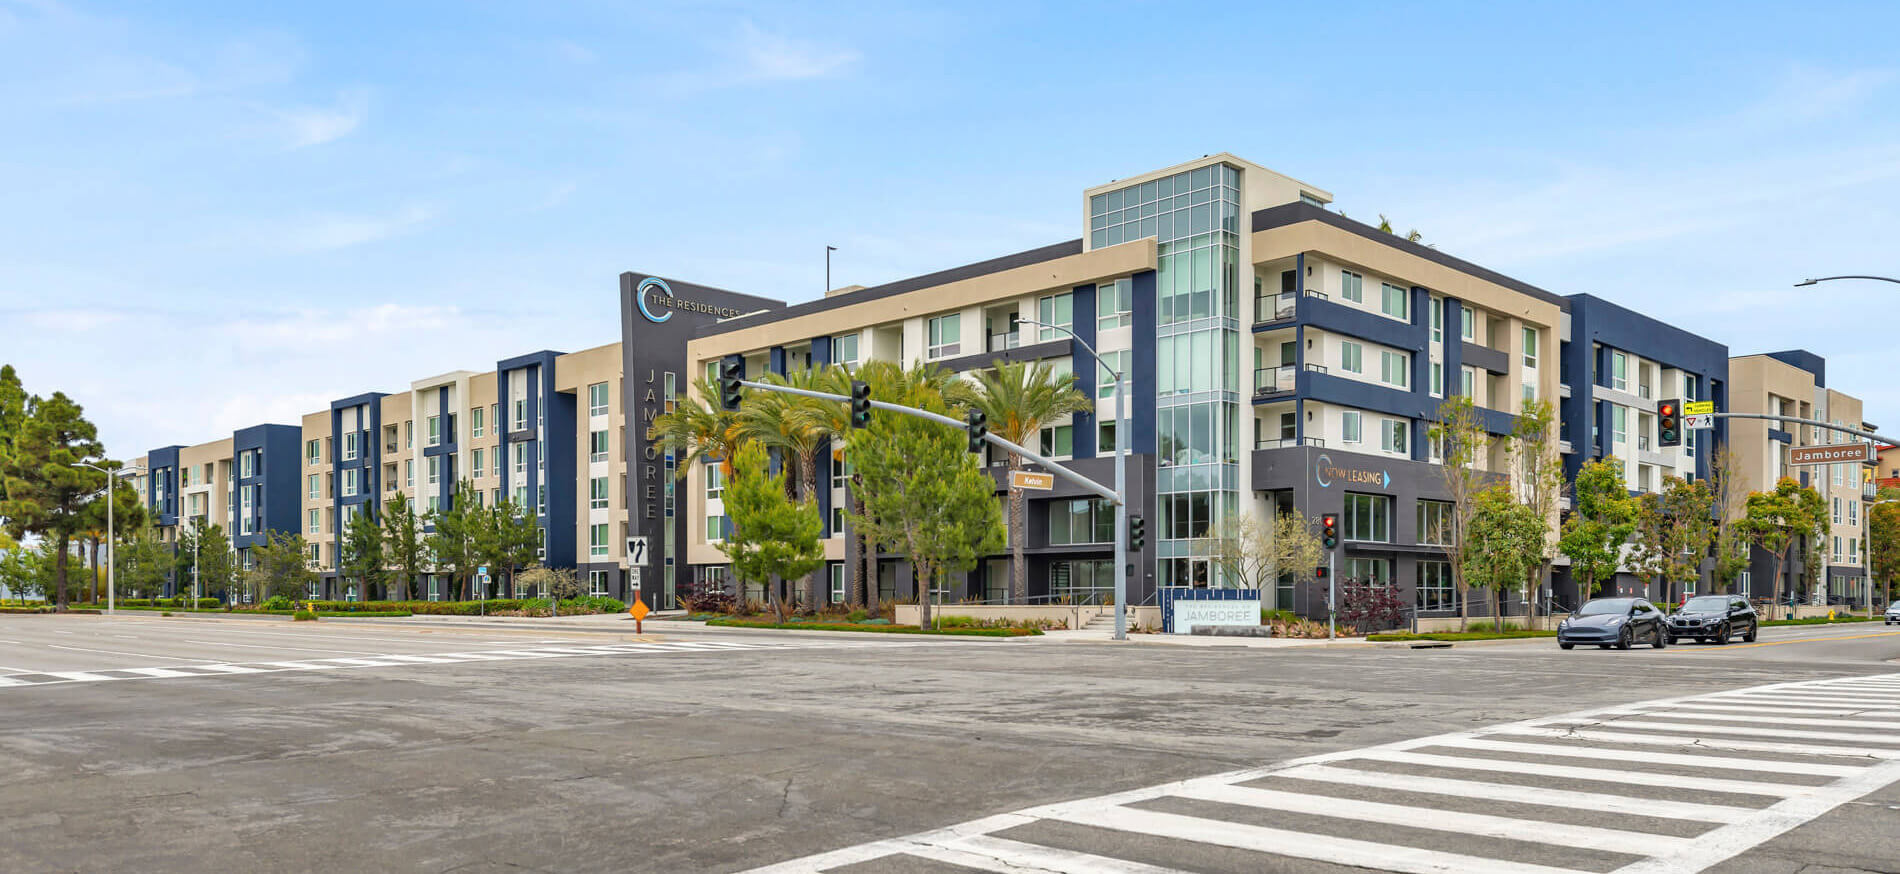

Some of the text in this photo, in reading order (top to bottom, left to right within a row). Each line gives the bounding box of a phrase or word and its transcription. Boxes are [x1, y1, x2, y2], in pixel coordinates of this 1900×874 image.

[652, 294, 672, 307] THE
[1795, 449, 1862, 461] Jamboree
[1325, 466, 1382, 485] NOW LEASING
[1184, 610, 1251, 621] JAMBOREE
